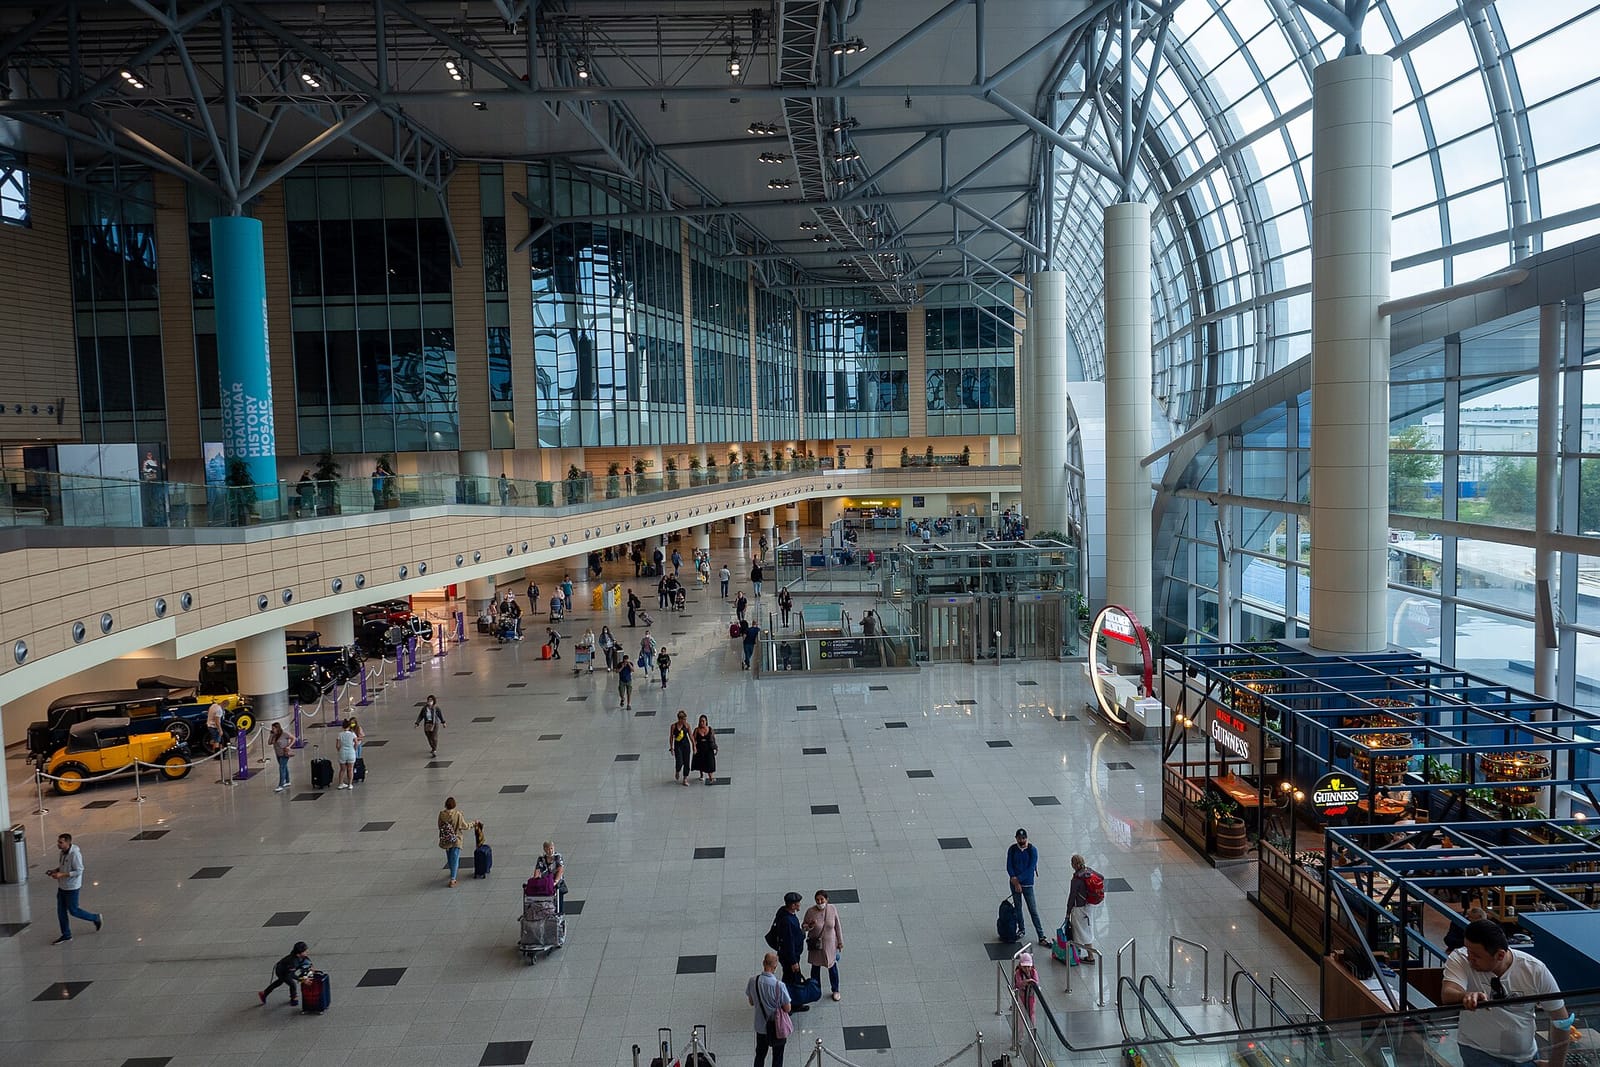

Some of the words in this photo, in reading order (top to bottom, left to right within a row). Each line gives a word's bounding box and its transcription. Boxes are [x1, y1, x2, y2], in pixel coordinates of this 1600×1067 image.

[224, 388, 235, 458] GEOLOGY
[232, 383, 247, 458] GRAMMAR
[245, 395, 260, 457] HISTORY
[258, 400, 271, 456] MOSAIC
[1212, 719, 1249, 759] GUINNESS
[1313, 790, 1360, 804] GUINNESS
